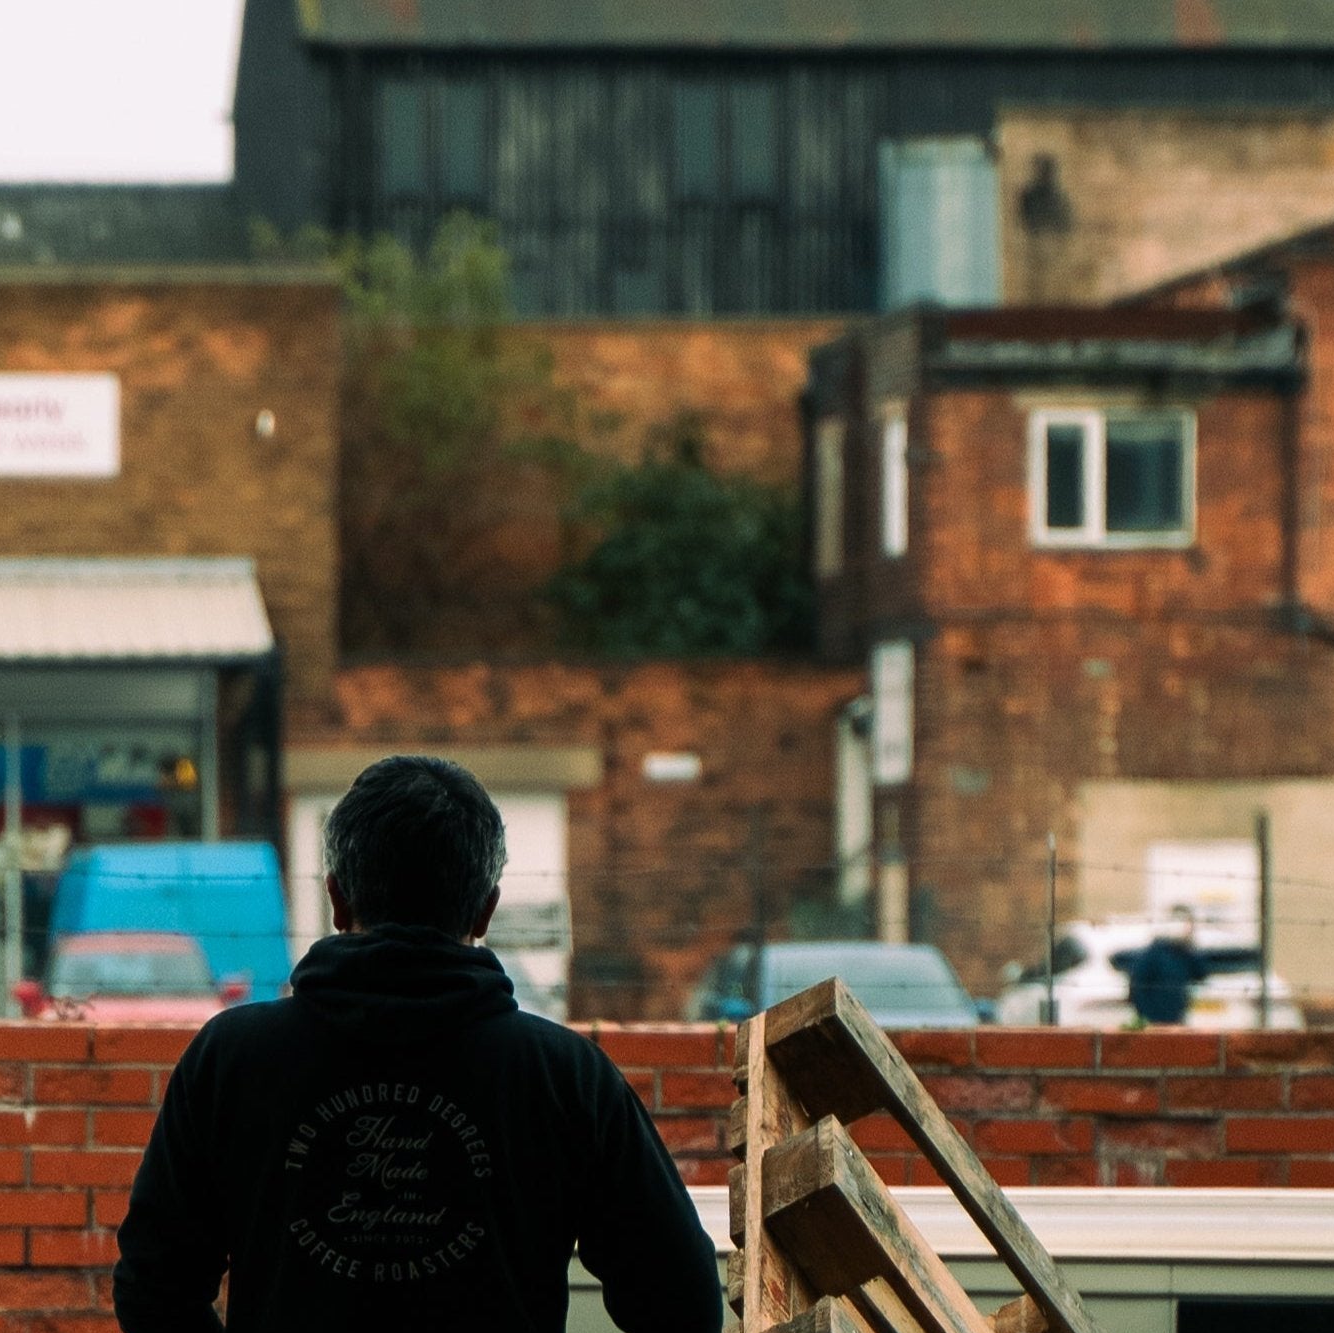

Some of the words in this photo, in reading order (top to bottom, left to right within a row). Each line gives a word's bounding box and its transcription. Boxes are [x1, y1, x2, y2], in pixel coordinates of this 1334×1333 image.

[285, 1123, 317, 1171] TWO
[315, 1083, 420, 1122] HUNDRED
[428, 1094, 492, 1178] DEGREES
[346, 1115, 434, 1150] Hand
[347, 1152, 429, 1190] Made
[327, 1191, 449, 1230] England
[289, 1218, 362, 1279] COFFEE
[374, 1221, 486, 1282] ROASTERS
